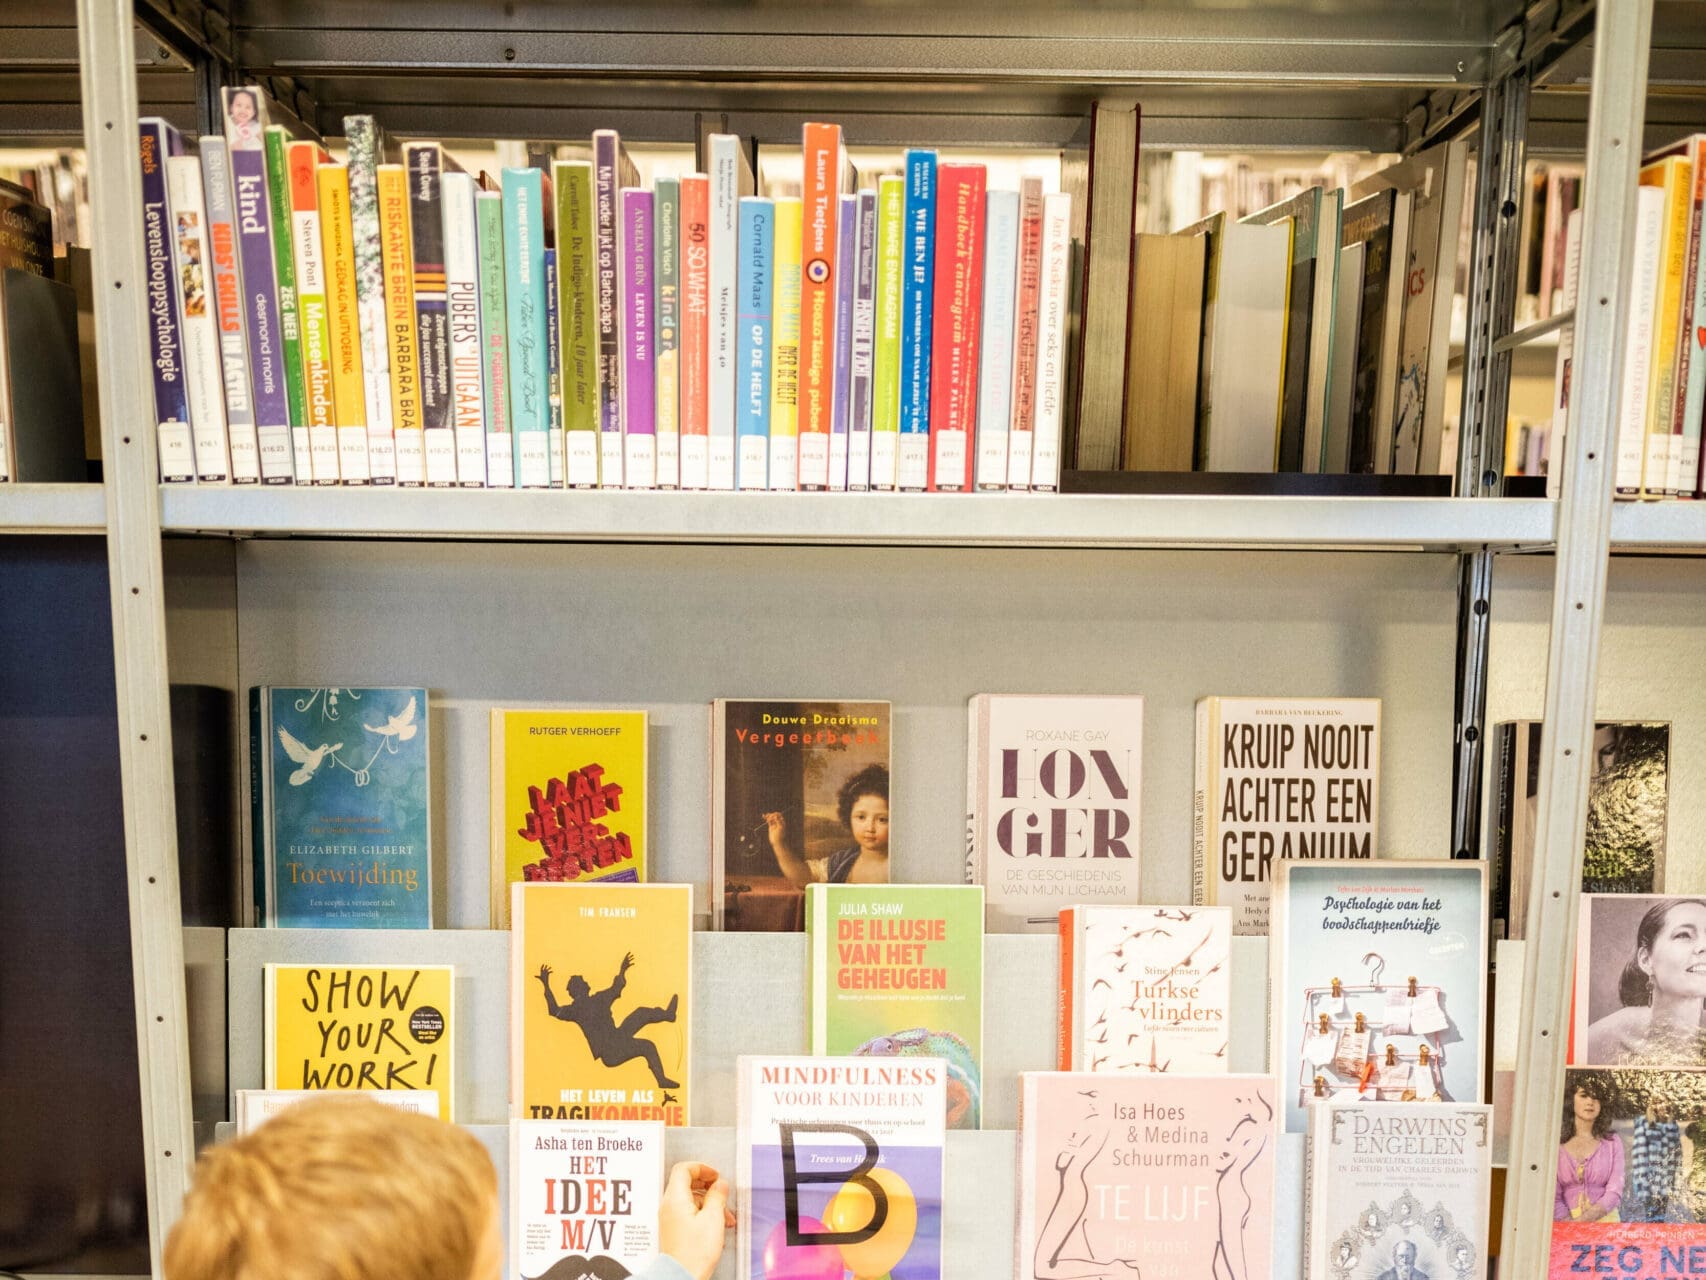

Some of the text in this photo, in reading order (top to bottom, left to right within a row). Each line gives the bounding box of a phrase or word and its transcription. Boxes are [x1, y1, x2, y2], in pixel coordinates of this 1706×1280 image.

[238, 175, 265, 234] kind
[813, 150, 829, 252] Laura Tietjens
[302, 219, 318, 287] Steven Pont
[387, 197, 408, 319] RISKANTE BREIN
[598, 166, 614, 333] Mijn vader lijkt op Barbapapa
[752, 214, 764, 308] Cornald Maas
[145, 202, 178, 381] Levenslooppsychologie
[280, 286, 297, 340] ZEG NEE!
[451, 282, 476, 343] PUBERS
[255, 293, 275, 394] desmond morris
[750, 325, 762, 417] OP DE HELFT
[454, 357, 481, 427] UITGAAN
[763, 713, 878, 726] Douwe Draaisma
[571, 728, 621, 736] VERHOEFF
[735, 729, 879, 747] Vergeetboek
[1026, 729, 1110, 742] ROXANE GAY
[1224, 724, 1374, 770] KRUIP NOOIT
[1000, 748, 1130, 800] HON
[528, 763, 604, 815] LAAT
[1222, 777, 1372, 823] ACHTER EEN
[518, 783, 623, 841] JE NIET
[996, 807, 1133, 859] GER
[290, 846, 413, 854] ELIZABETH GILBERT
[286, 861, 418, 891] Toewijding
[1006, 869, 1121, 882] DE GESCHIEDENIS
[1002, 884, 1127, 897] VAN MIJN LICHAAM
[579, 906, 637, 918] TIM FRANSEN
[838, 903, 903, 916] JULIA SHAW
[1323, 896, 1441, 913] Psychologie van het
[838, 919, 945, 941] DE ILLUSIE
[1323, 917, 1441, 934] boodschappenbriefje
[838, 944, 926, 965] VAN HET
[838, 968, 946, 990] GEHEUGEN
[1145, 966, 1200, 976] Stine Jensen
[302, 969, 420, 1013] SHOW
[1131, 980, 1199, 999] Turkse
[1140, 1002, 1223, 1020] vlinders
[318, 1018, 411, 1058] YOUR
[303, 1054, 437, 1090] WORK!
[761, 1066, 936, 1085] MINDFULNESS
[560, 1089, 654, 1103] HET LEVEN ALS
[774, 1091, 924, 1107] VOOR KINDEREN
[530, 1105, 683, 1126] TRAGIKOMEDIE
[1114, 1103, 1185, 1120] Isa Hoes
[1127, 1126, 1209, 1144] & Medina
[1353, 1115, 1467, 1136] DARWINS
[535, 1136, 643, 1151] Asha ten Broeke
[1354, 1136, 1464, 1155] ENGELEN
[569, 1156, 608, 1175] HET
[1112, 1149, 1209, 1167] Schuurman
[544, 1179, 632, 1215] IDEE
[1094, 1185, 1210, 1222] TE LIJF
[561, 1219, 616, 1253] M/V
[1571, 1245, 1643, 1272] ZEG
